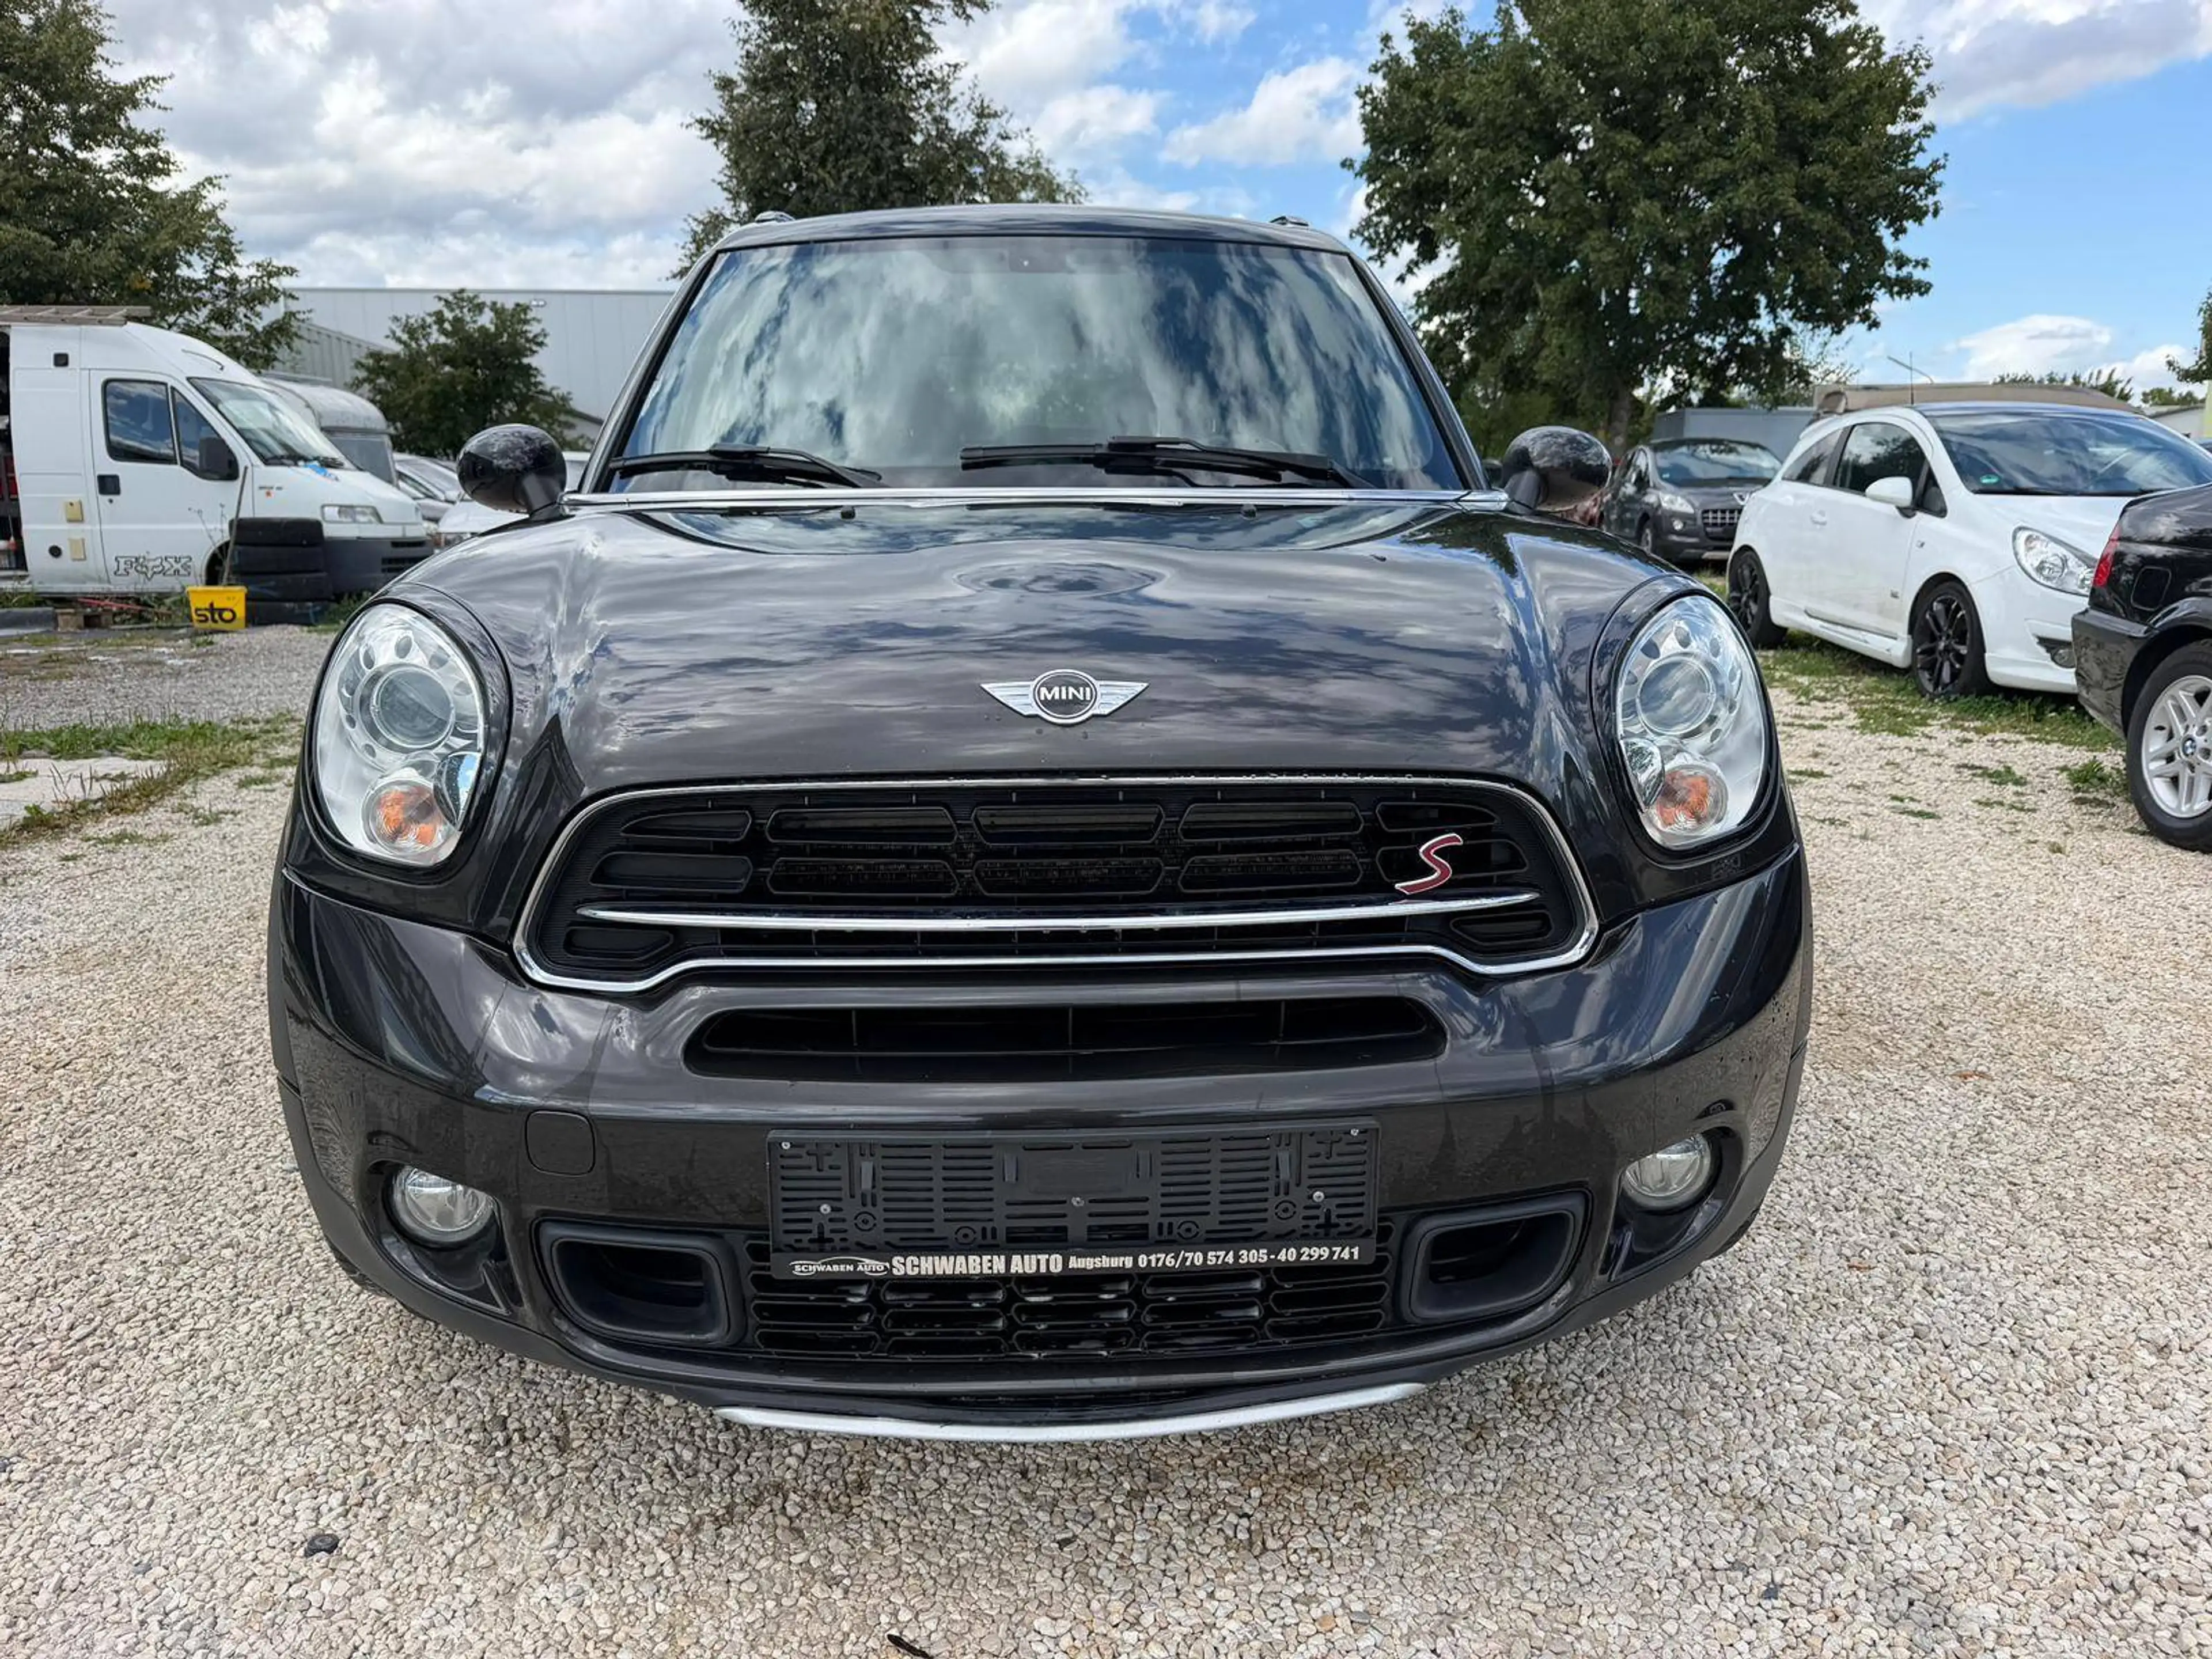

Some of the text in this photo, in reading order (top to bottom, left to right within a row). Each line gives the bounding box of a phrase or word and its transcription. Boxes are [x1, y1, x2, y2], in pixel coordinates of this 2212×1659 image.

[194, 601, 237, 624] sto
[1039, 686, 1091, 701] MINI
[1394, 832, 1464, 895] S
[794, 1262, 885, 1272] SCHWABEN AUTO
[891, 1255, 1006, 1276] SCHWABEN
[1010, 1253, 1063, 1274] AUTO
[1069, 1255, 1133, 1269] Augsburg
[1138, 1250, 1203, 1268] 0176/70
[1207, 1250, 1234, 1266] 574
[1300, 1246, 1328, 1261] 299
[1332, 1245, 1360, 1260] 741
